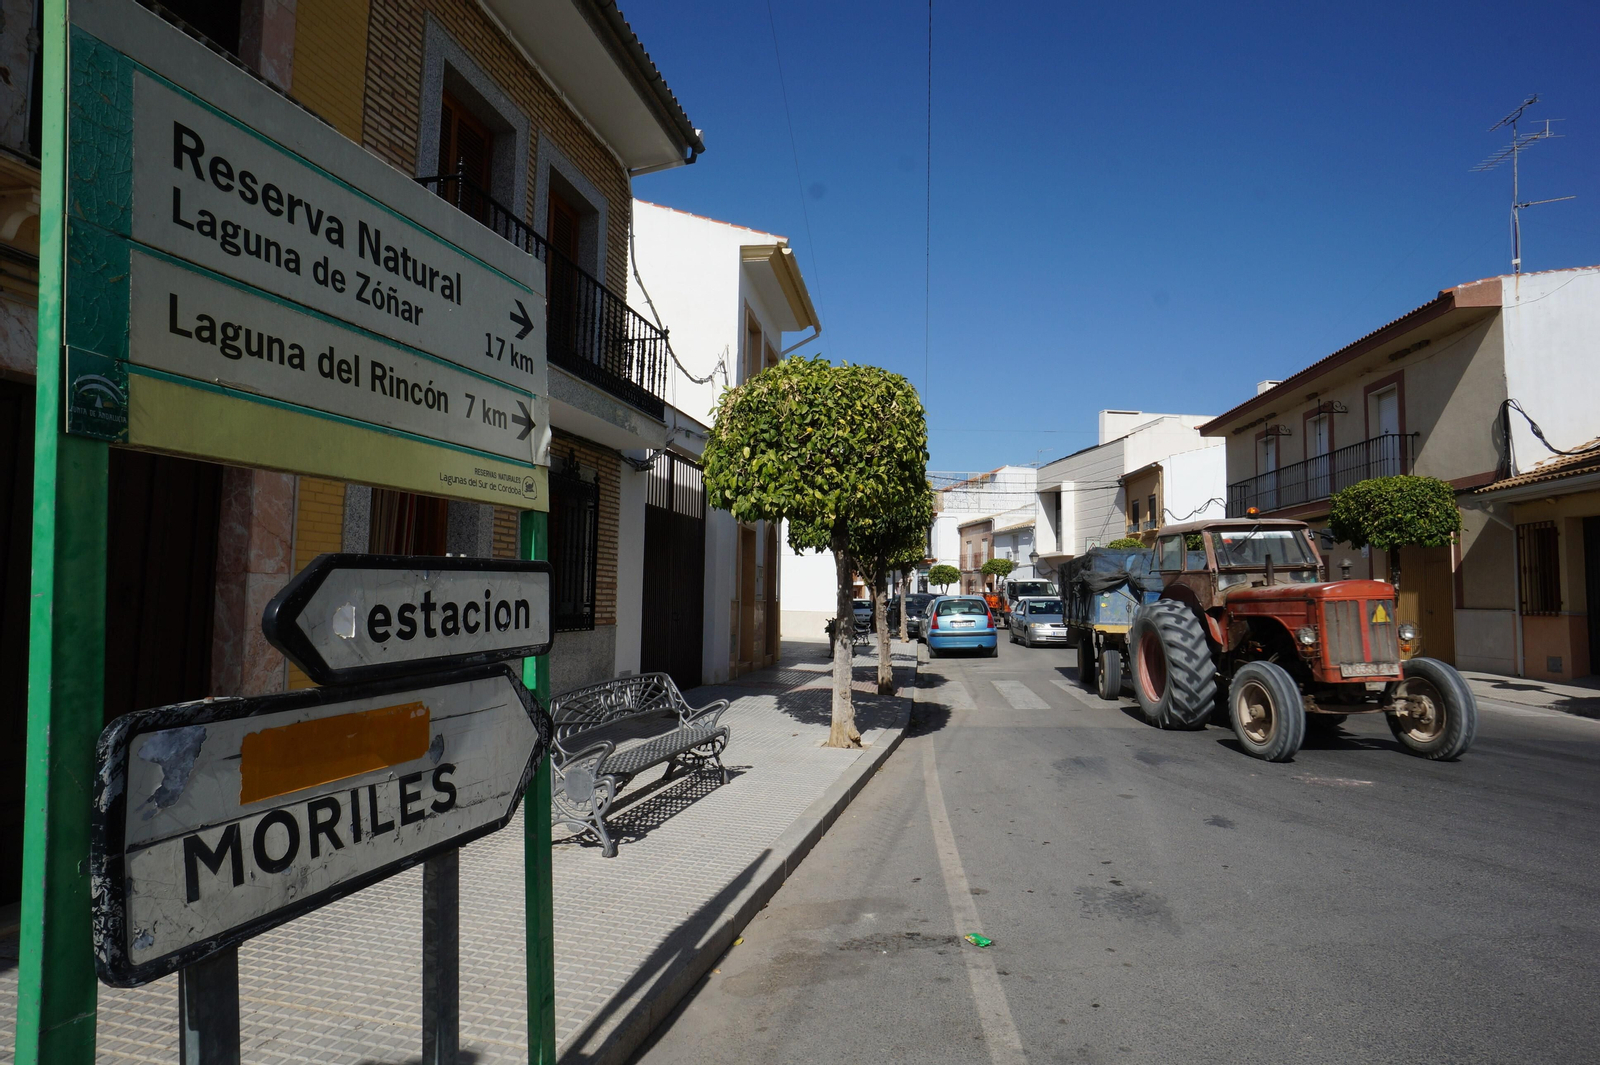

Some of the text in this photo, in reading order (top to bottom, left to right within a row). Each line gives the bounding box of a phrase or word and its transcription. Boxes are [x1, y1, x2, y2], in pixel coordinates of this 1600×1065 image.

[172, 119, 462, 306] Reserva Natural
[171, 185, 424, 327] Laguna de Zóñar
[168, 292, 508, 430] Laguna del Rincón 7 km
[484, 332, 534, 375] 17 km
[89, 409, 96, 417] DE
[439, 472, 467, 486] Lagunas
[468, 477, 478, 488] del
[478, 479, 488, 489] Sur
[489, 481, 497, 491] de
[474, 467, 521, 484] RESERVAS NATURALES
[367, 588, 530, 644] estacion
[183, 762, 458, 905] MORILES
